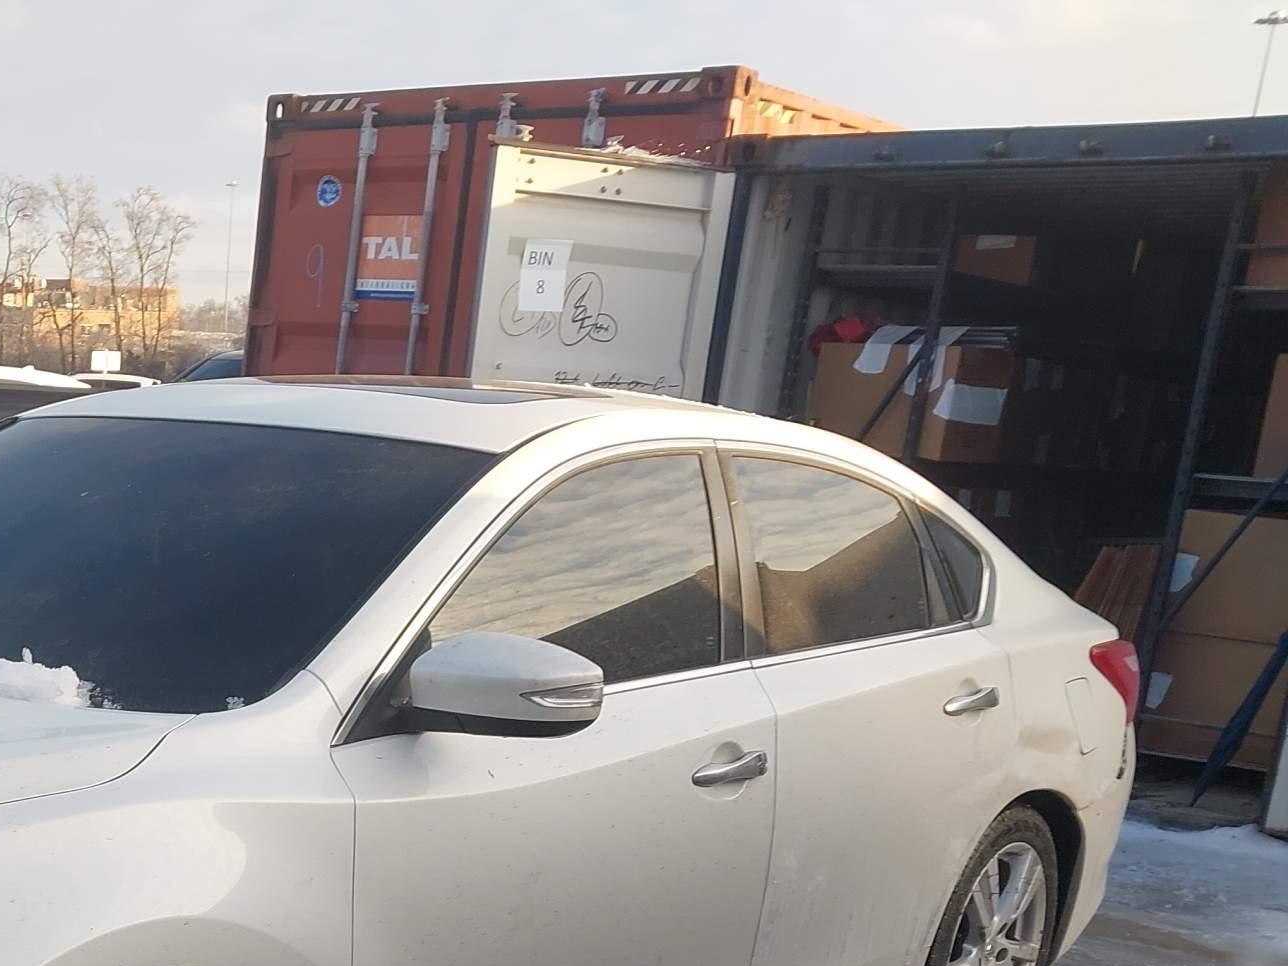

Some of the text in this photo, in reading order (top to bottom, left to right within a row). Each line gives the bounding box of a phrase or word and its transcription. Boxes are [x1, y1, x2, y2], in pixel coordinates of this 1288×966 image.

[362, 236, 420, 260] TAL
[527, 250, 554, 266] BIN
[535, 279, 545, 294] 8
